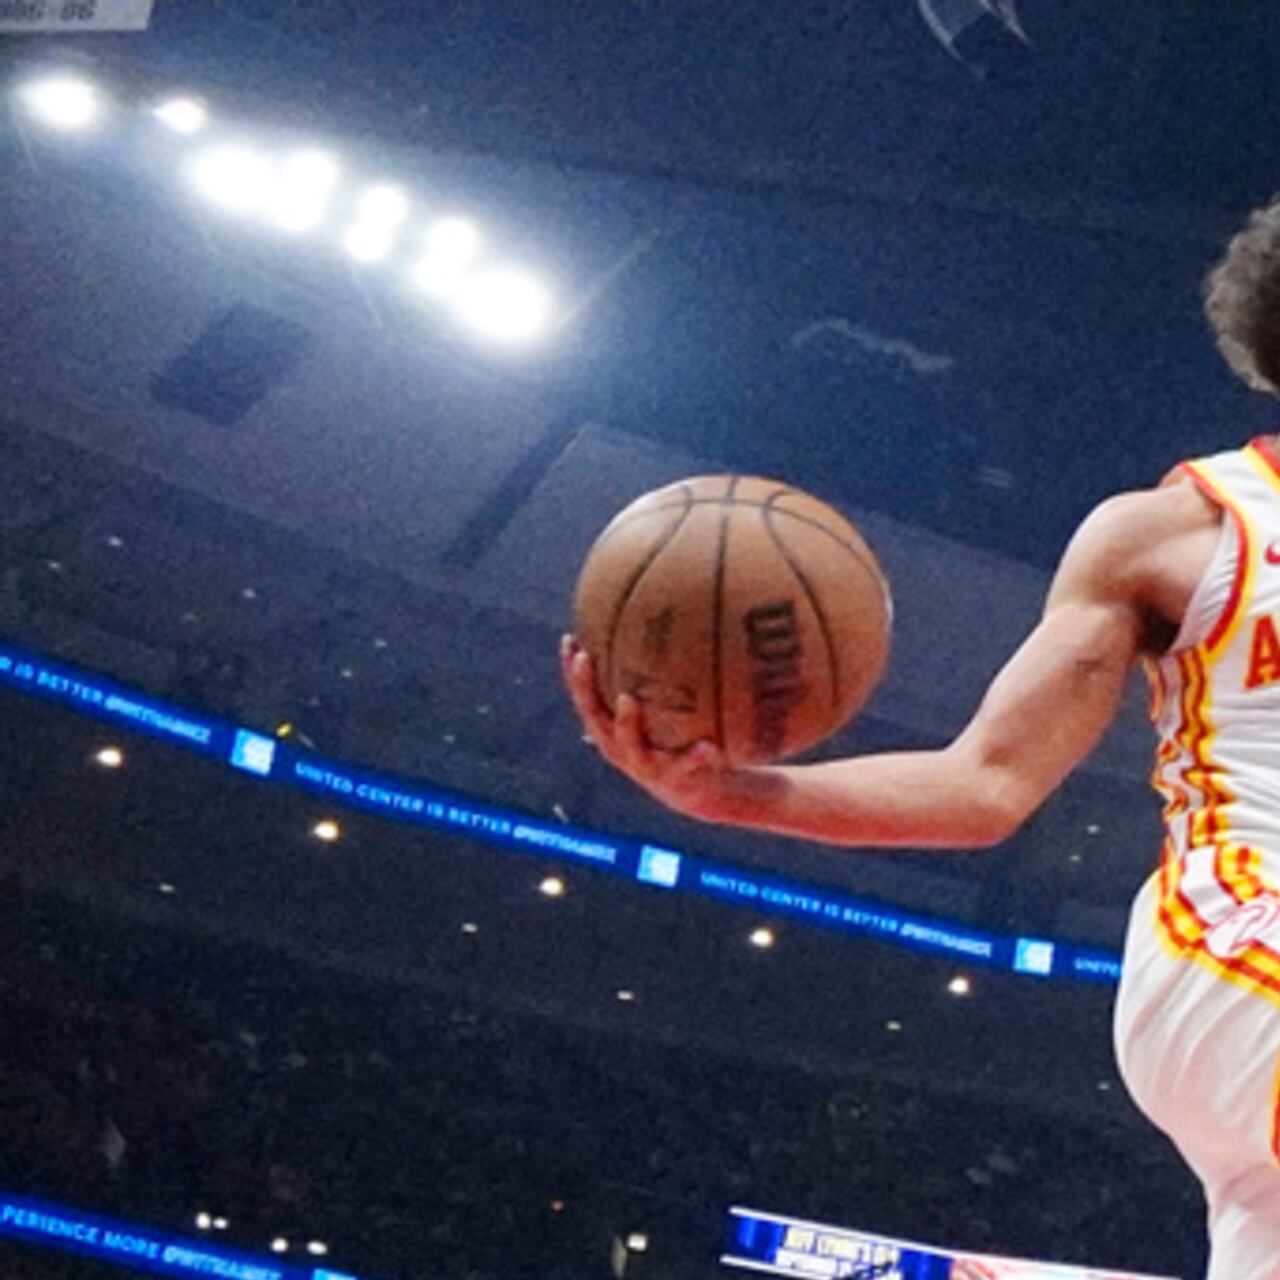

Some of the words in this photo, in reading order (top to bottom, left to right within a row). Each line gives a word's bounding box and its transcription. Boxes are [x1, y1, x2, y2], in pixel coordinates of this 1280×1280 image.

[295, 762, 353, 793] UNITED
[356, 784, 424, 814] CENTER
[449, 806, 511, 835] BETTER
[701, 871, 758, 898] UNITED
[761, 885, 821, 912] CENTER
[843, 906, 898, 933] BETTER
[103, 1231, 160, 1259] MORE
